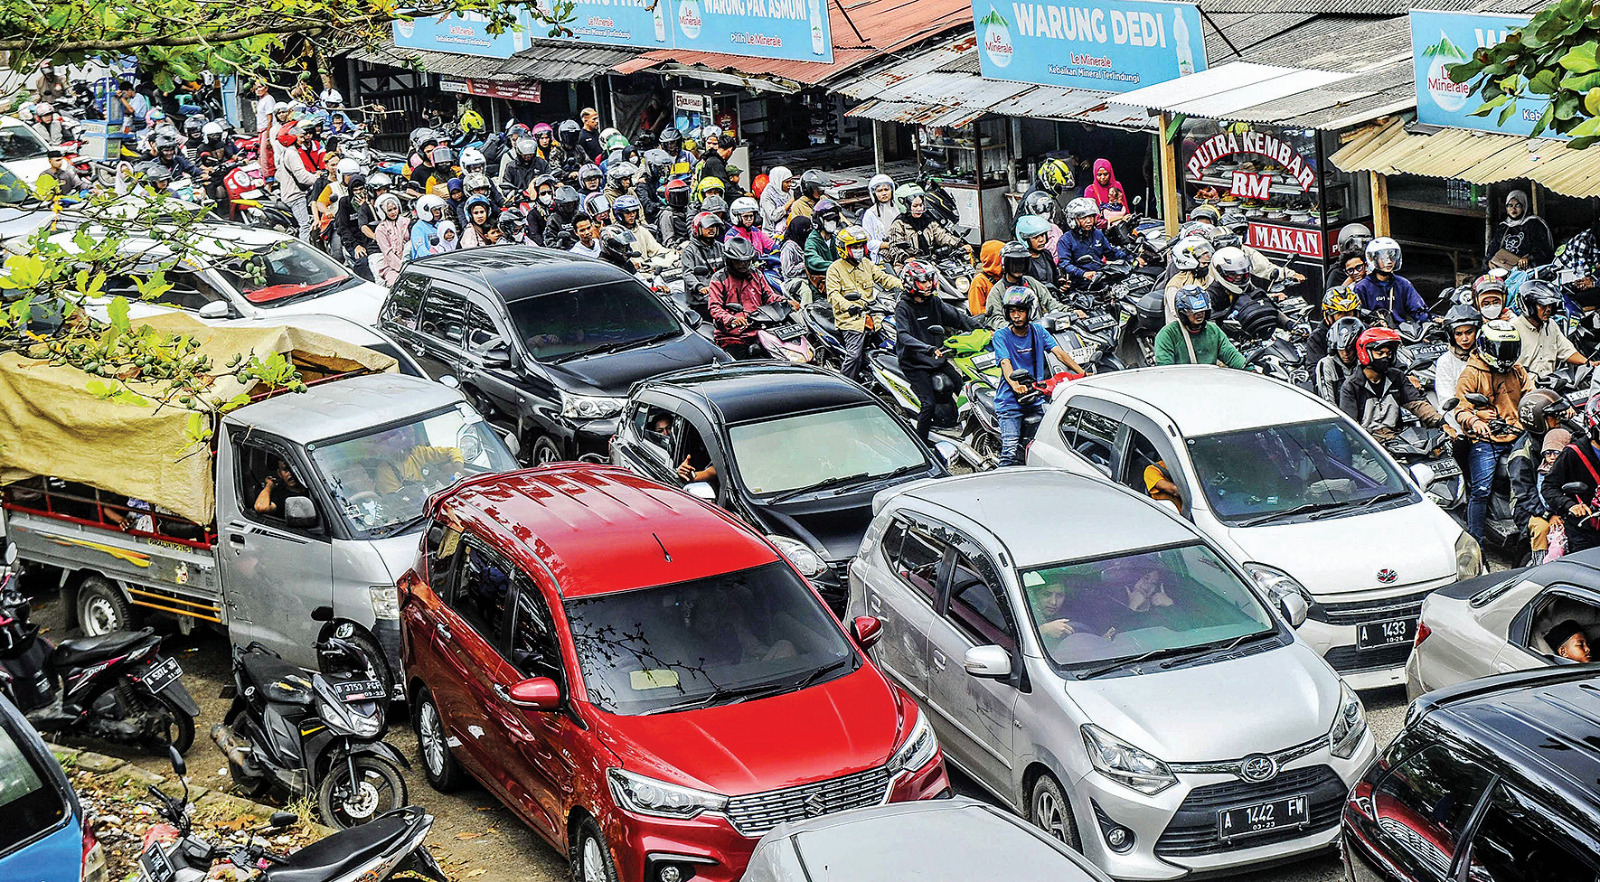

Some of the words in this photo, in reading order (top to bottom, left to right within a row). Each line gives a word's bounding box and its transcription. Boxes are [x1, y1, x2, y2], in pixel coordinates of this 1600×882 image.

[1013, 2, 1107, 43] WARUNG
[1110, 9, 1167, 48] DEDI
[730, 32, 745, 43] Pilih
[746, 32, 755, 45] Le
[755, 34, 783, 47] Minerale
[992, 32, 1002, 43] Le
[985, 41, 1013, 54] Minerale
[1070, 52, 1081, 66] Le
[1081, 54, 1113, 68] Minerale
[1048, 63, 1077, 77] Kebaikan
[1078, 67, 1102, 79] Mineral
[1102, 70, 1140, 84] Terlindungi
[1187, 132, 1241, 180] PUTRA
[1241, 131, 1316, 193] KEMBAR
[1230, 170, 1272, 200] RM
[1254, 224, 1320, 255] MAKAN
[1362, 626, 1368, 640] A
[1382, 621, 1406, 637] 1433
[146, 677, 154, 685] A
[336, 685, 343, 693] B
[344, 683, 363, 691] 3753
[1225, 812, 1232, 829] A
[1246, 804, 1274, 824] 1442
[1288, 798, 1303, 816] FW
[1252, 821, 1275, 830] 03-23
